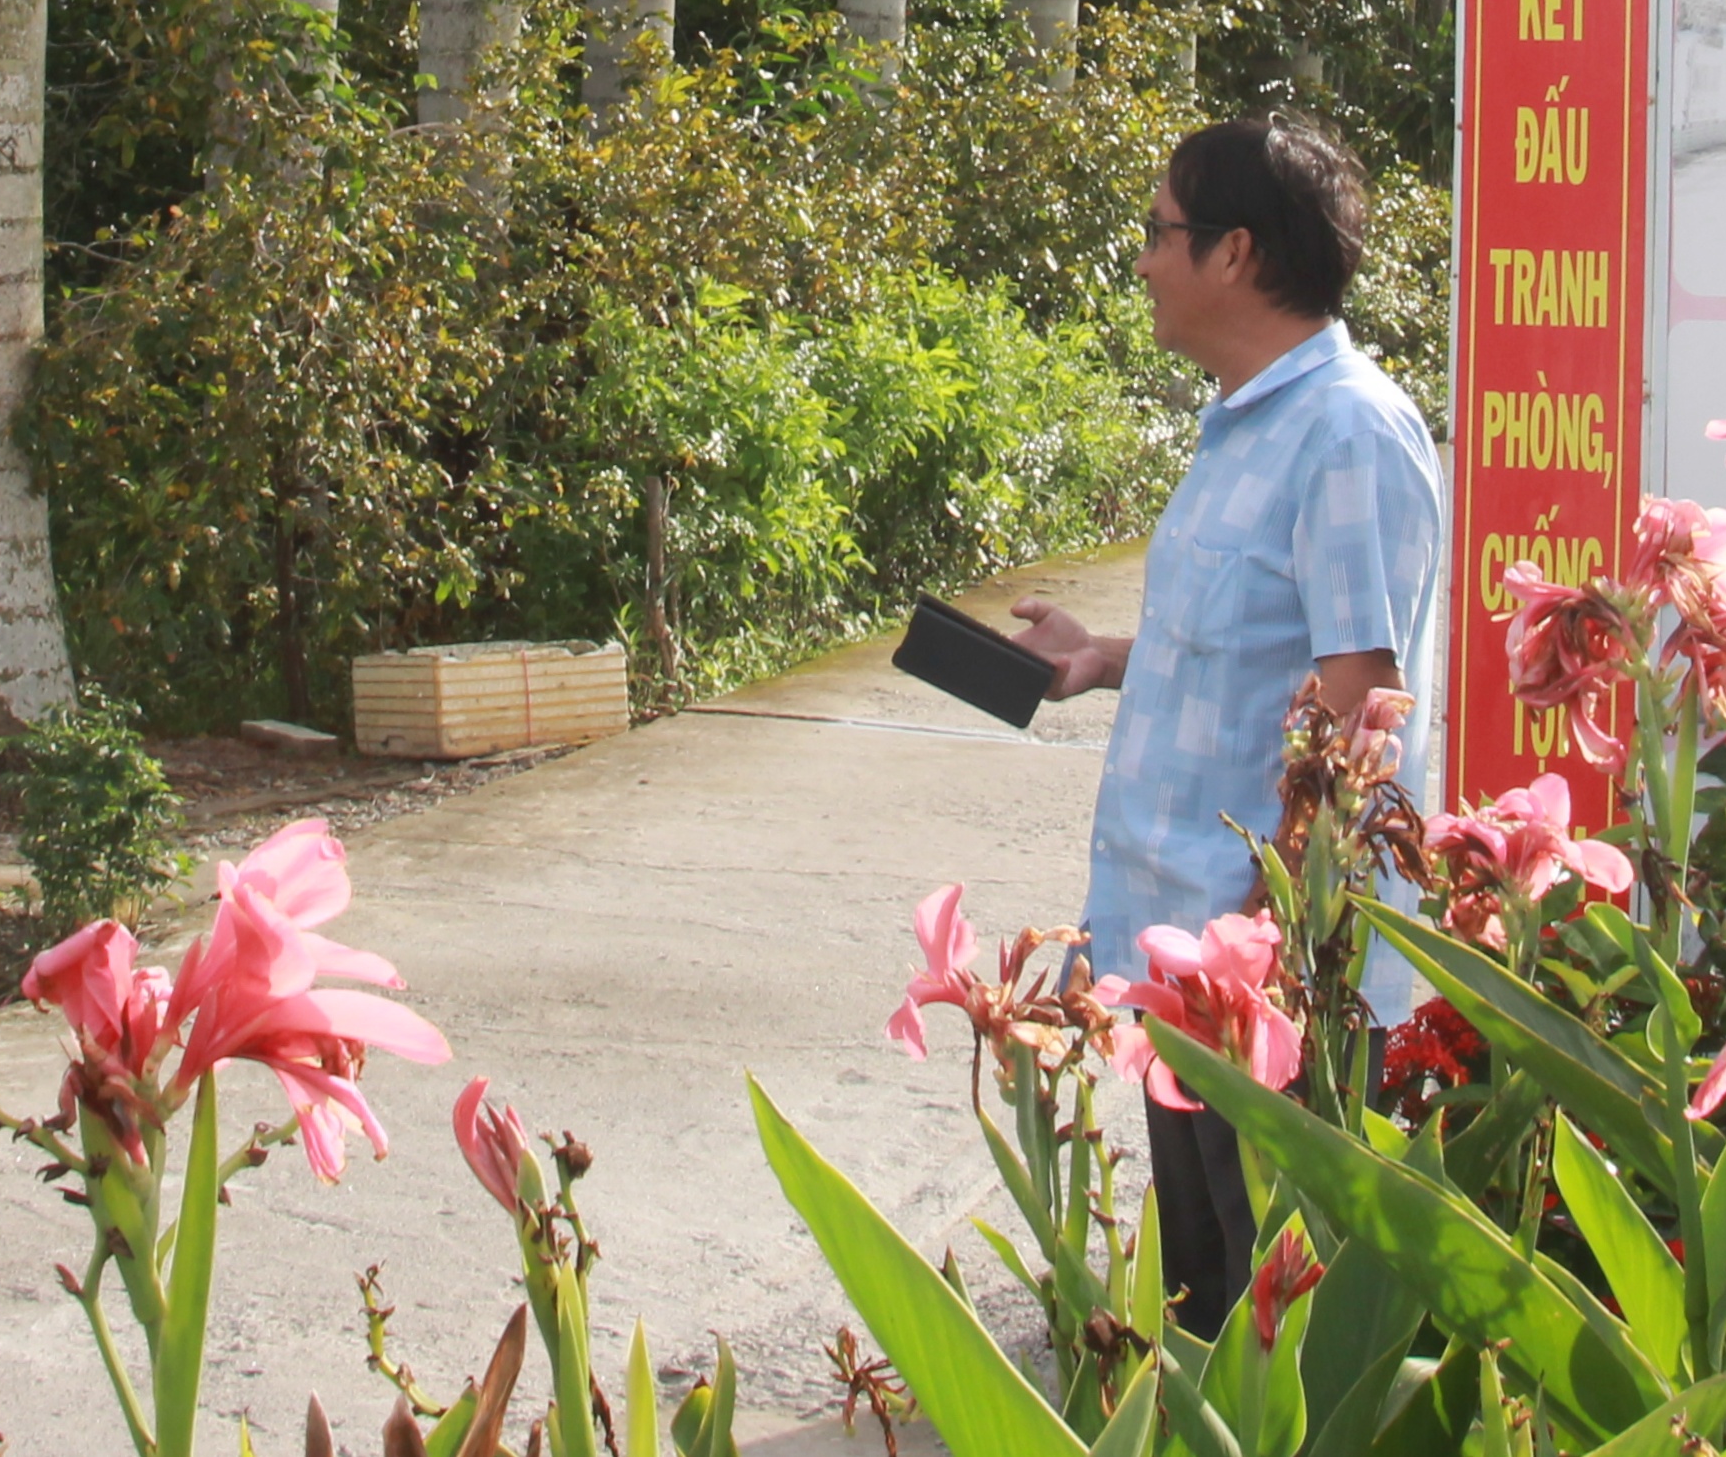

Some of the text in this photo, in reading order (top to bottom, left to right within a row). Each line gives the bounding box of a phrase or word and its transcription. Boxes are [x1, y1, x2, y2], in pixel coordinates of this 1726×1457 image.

[1513, 75, 1590, 186] ĐẤU
[1488, 247, 1610, 329] TRANH
[1481, 370, 1614, 488] PHÒNG,
